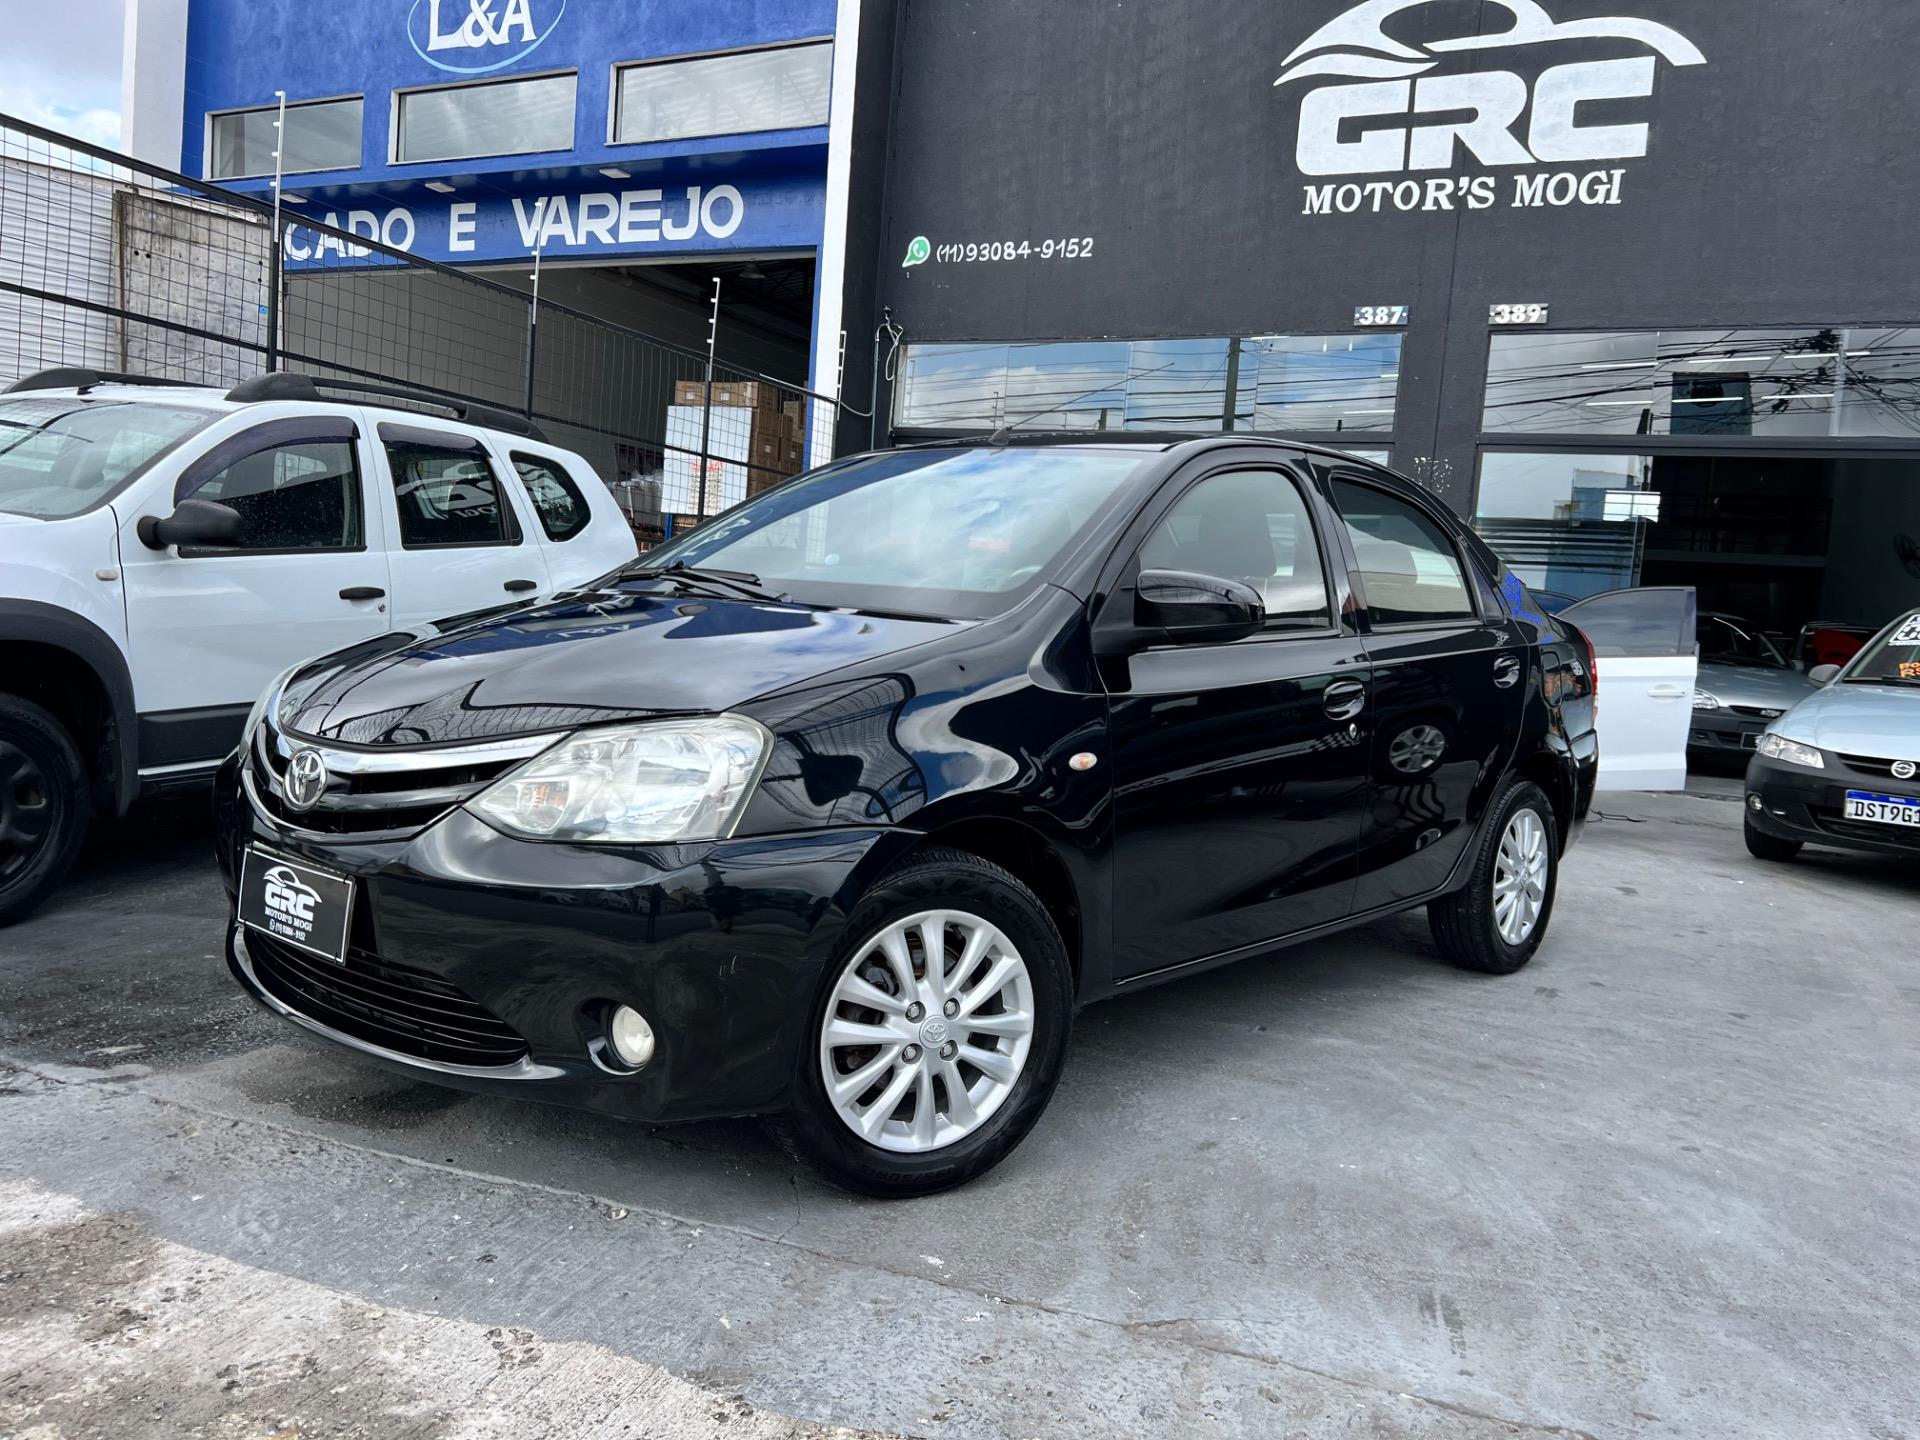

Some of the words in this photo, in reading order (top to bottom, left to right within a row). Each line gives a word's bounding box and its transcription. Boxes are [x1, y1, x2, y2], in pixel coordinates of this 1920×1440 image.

[427, 0, 537, 51] L&A
[1296, 56, 1656, 176] GRC
[1302, 176, 1496, 215] MOTOR'S
[1511, 169, 1627, 208] MOGI
[283, 207, 416, 261] CADO
[449, 202, 477, 252] E
[512, 184, 744, 248] VAREJO
[936, 237, 1095, 263] (11)93084-9152
[1358, 305, 1404, 326] 387
[1494, 303, 1542, 324] 389
[265, 882, 315, 921] GRC
